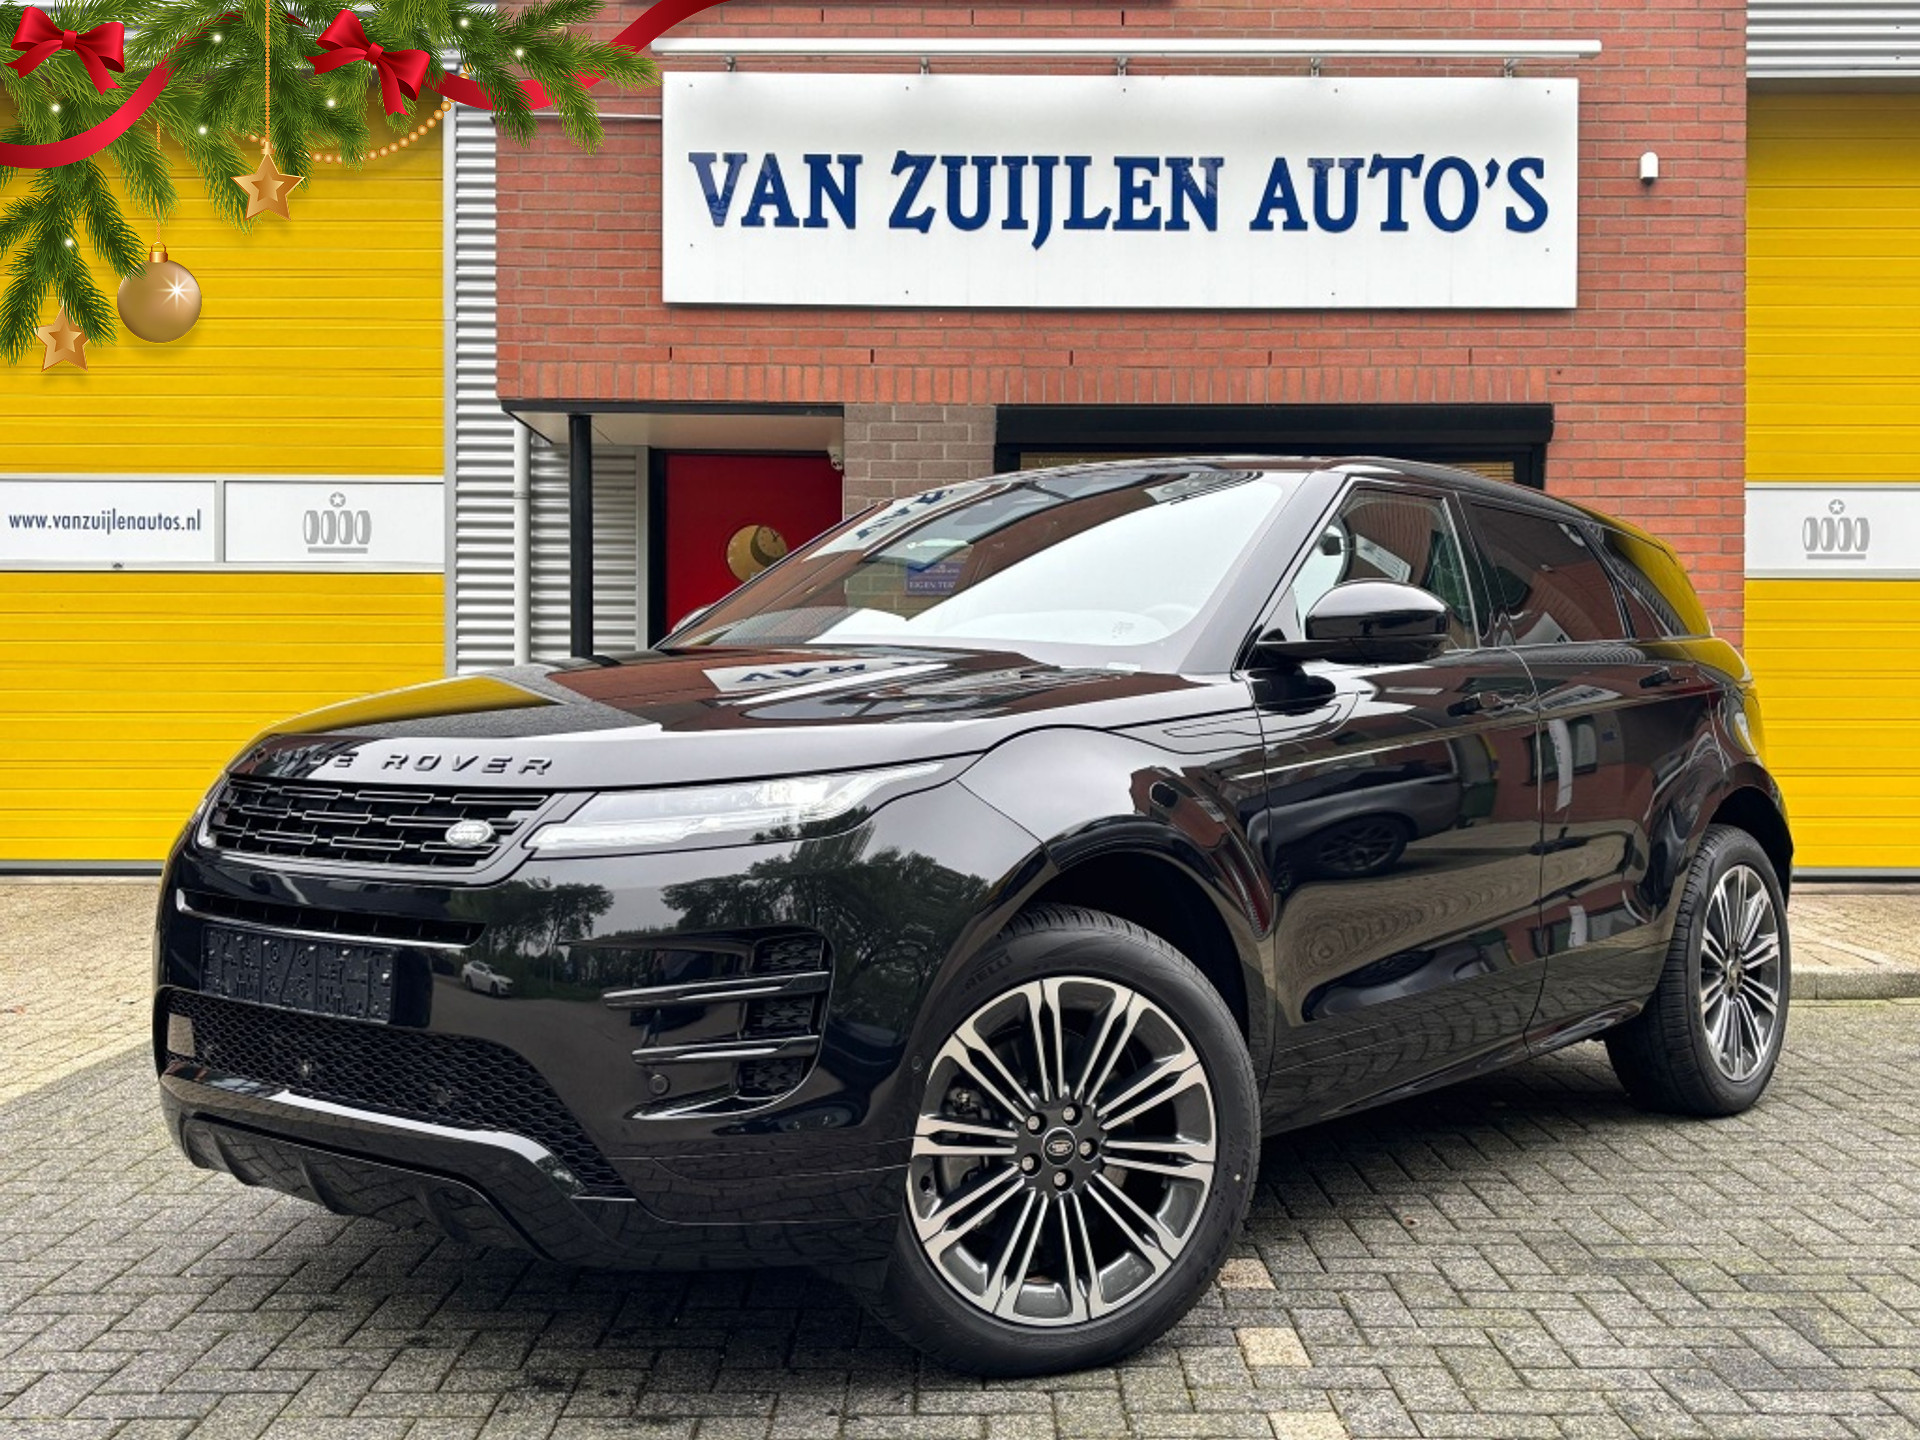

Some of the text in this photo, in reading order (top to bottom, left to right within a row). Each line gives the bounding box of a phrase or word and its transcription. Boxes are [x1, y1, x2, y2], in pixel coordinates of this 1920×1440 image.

[689, 151, 1549, 248] VAN ZUIJLEN AUTO'S
[9, 508, 200, 534] www.vanzuijlenautos.nl
[381, 754, 553, 776] ROVER
